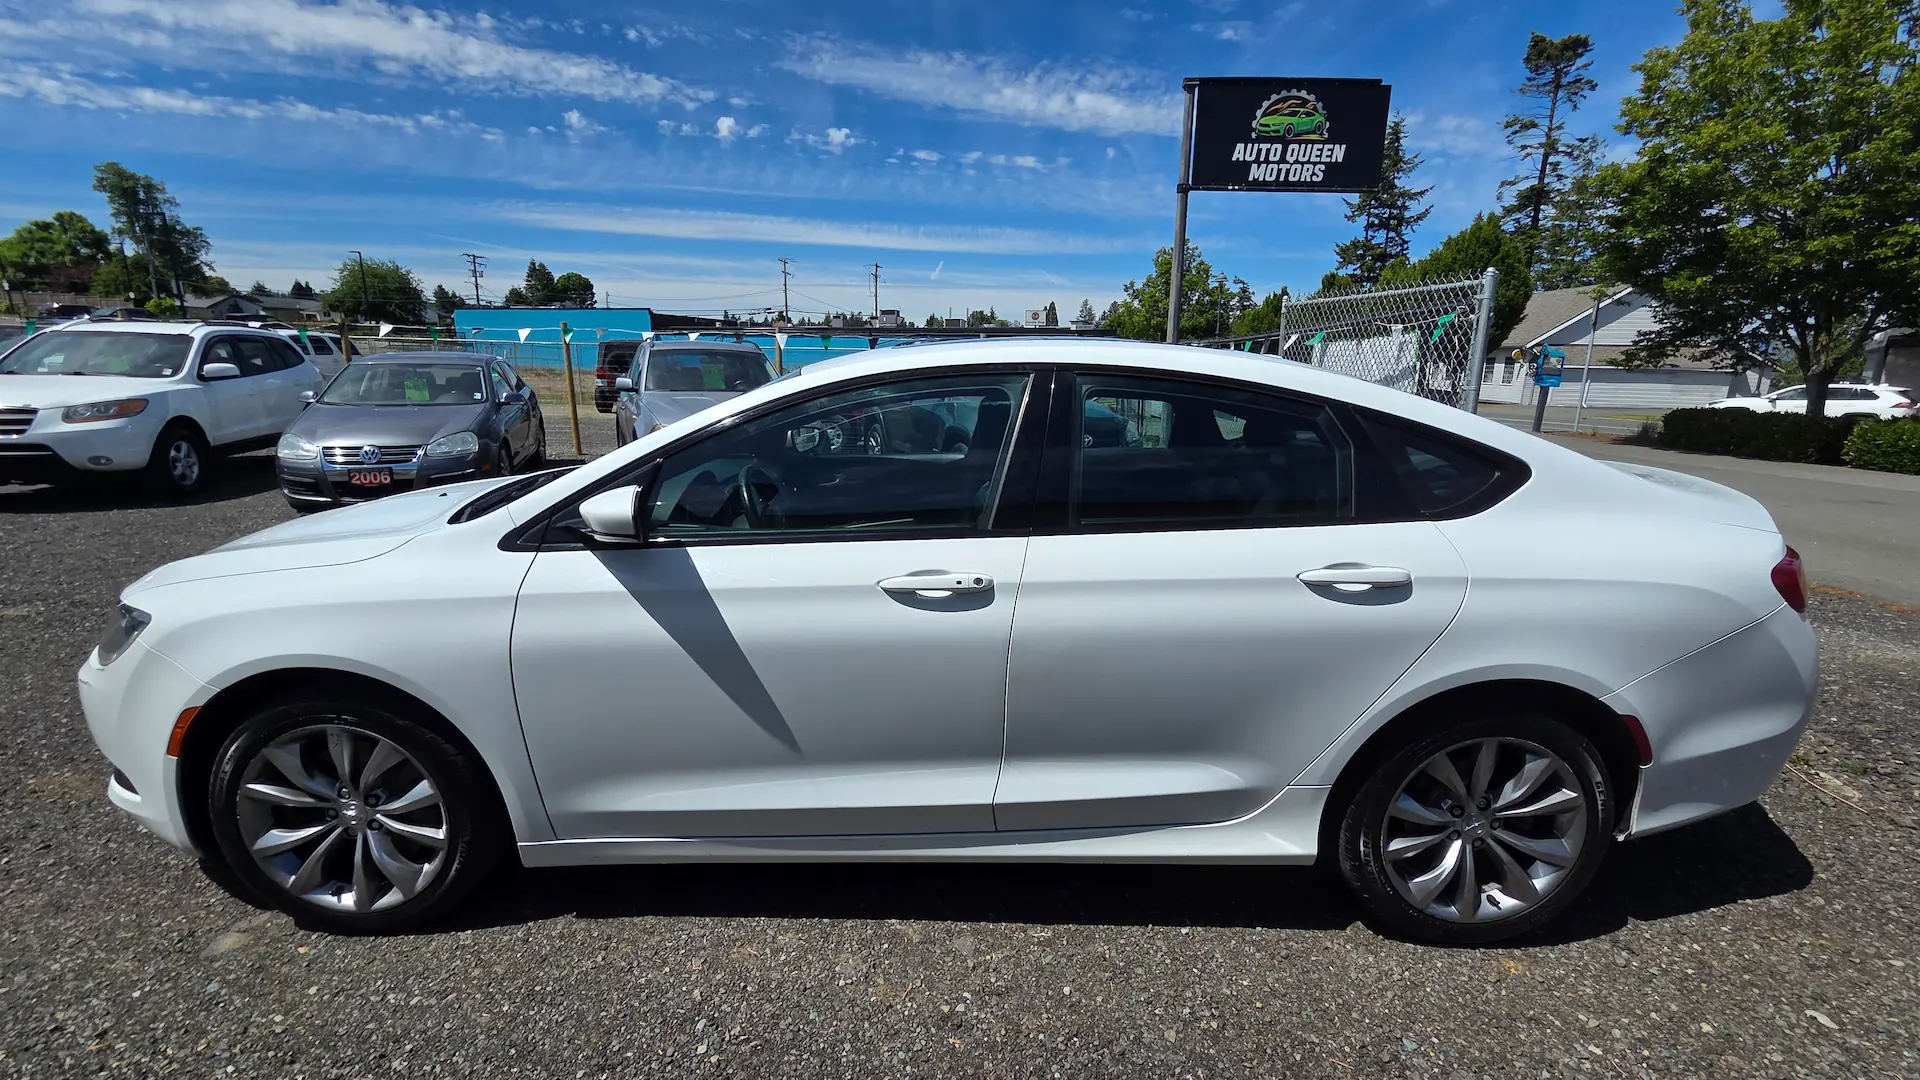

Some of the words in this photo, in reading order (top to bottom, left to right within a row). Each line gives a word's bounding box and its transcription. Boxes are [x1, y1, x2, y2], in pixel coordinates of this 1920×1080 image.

[1232, 143, 1282, 161] AUTO
[1285, 143, 1346, 163] QUEEN
[1248, 163, 1325, 181] MOTORS
[350, 471, 391, 483] 2006
